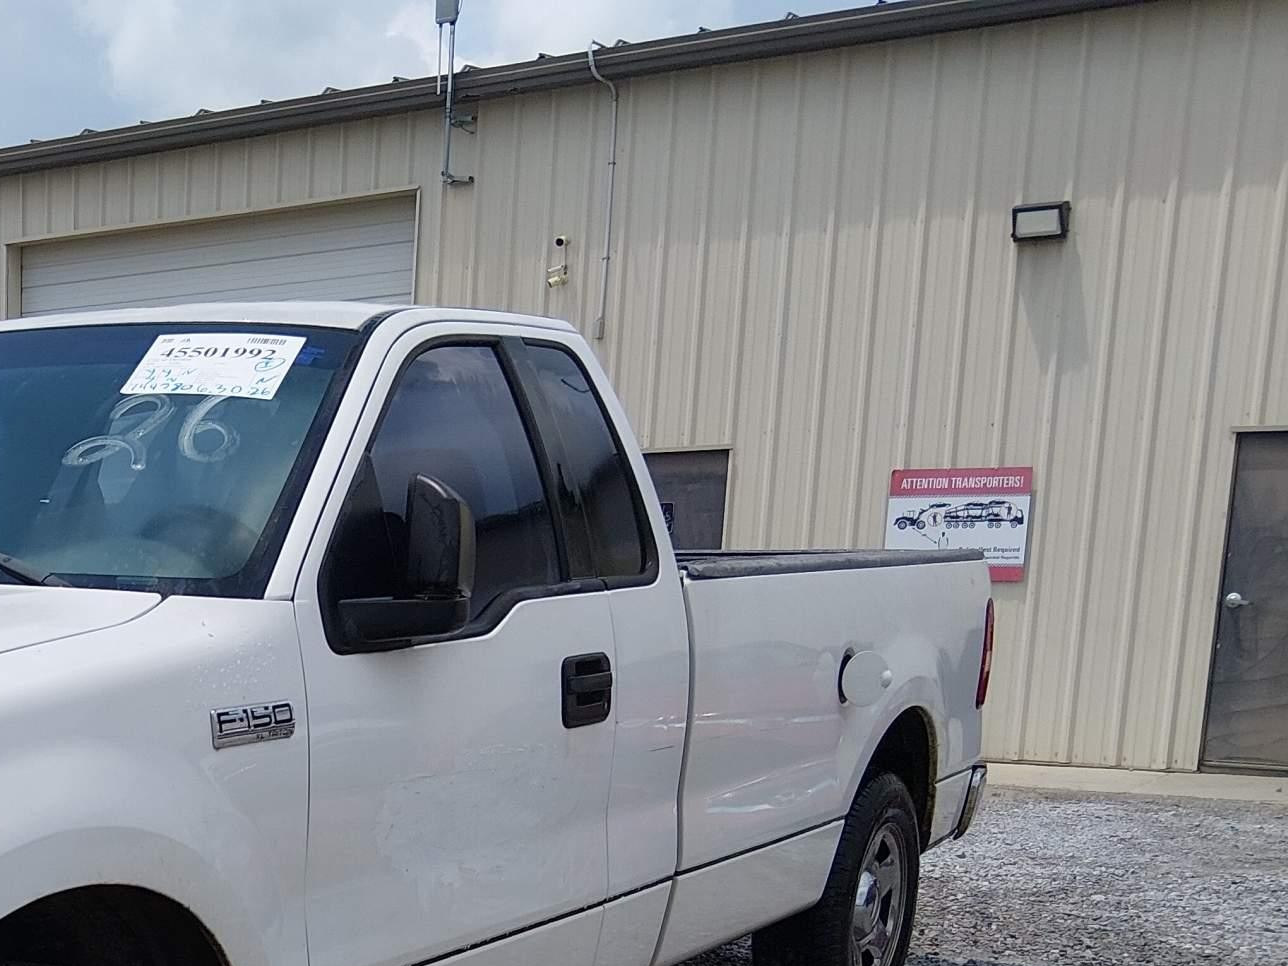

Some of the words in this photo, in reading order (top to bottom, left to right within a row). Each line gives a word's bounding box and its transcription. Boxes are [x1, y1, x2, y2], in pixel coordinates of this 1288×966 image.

[160, 346, 277, 361] 45501992
[900, 477, 949, 489] ATTENTION
[951, 476, 1024, 489] TRANSPORTERS!
[216, 702, 294, 734] F-150
